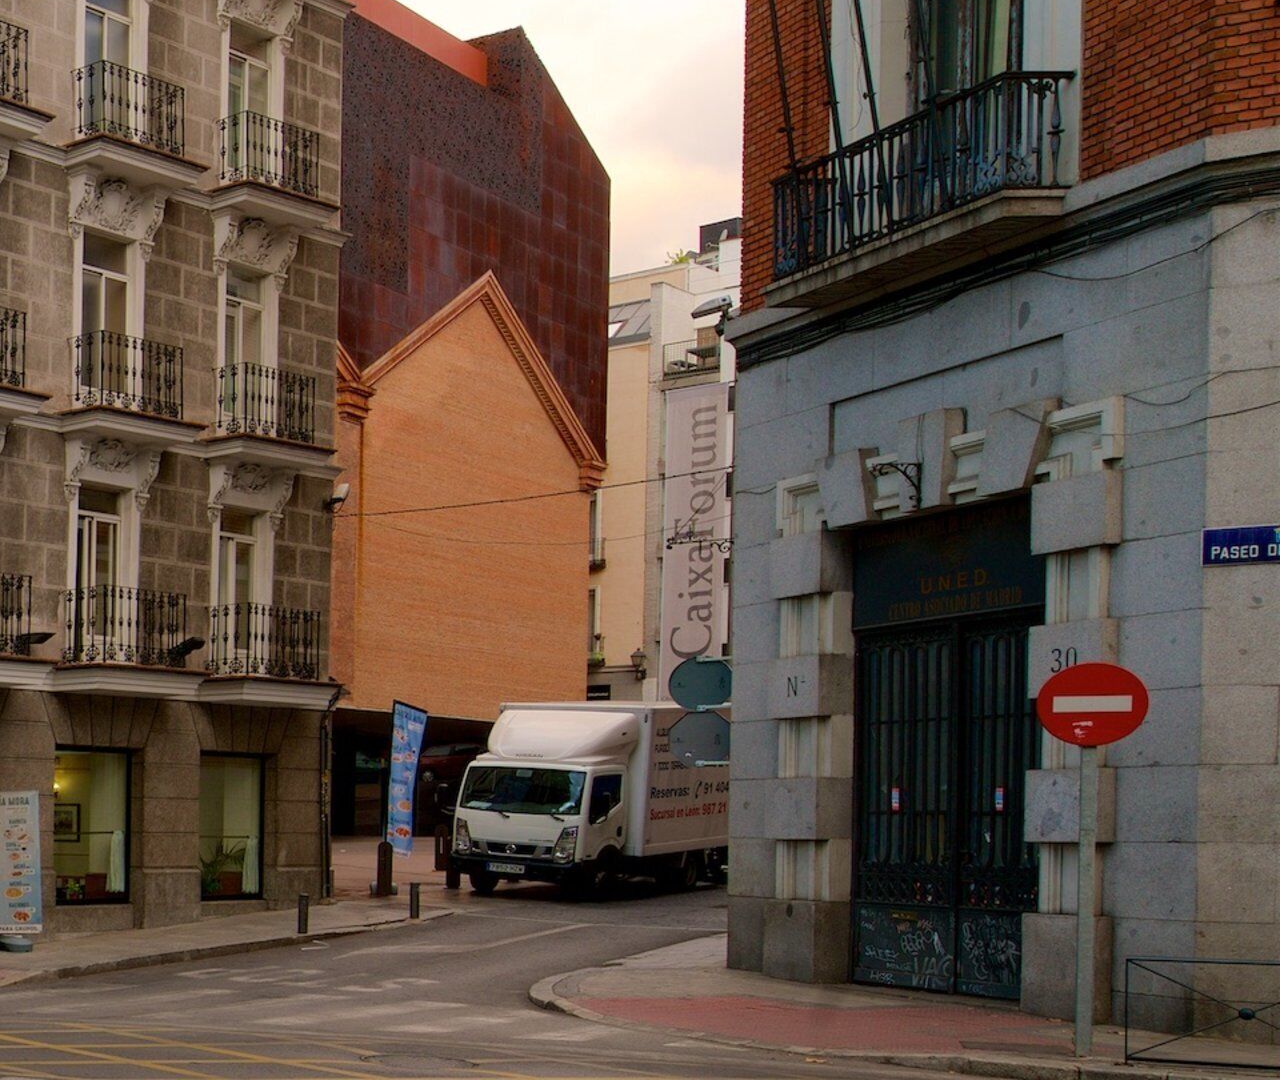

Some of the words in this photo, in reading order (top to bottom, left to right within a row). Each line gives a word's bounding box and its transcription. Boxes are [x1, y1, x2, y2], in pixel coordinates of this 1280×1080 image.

[670, 404, 718, 660] CaixaForum
[1211, 544, 1259, 560] PASEO
[1267, 542, 1280, 557] D
[1050, 646, 1077, 673] 30
[650, 786, 690, 799] Reservas:
[703, 782, 713, 794] 91
